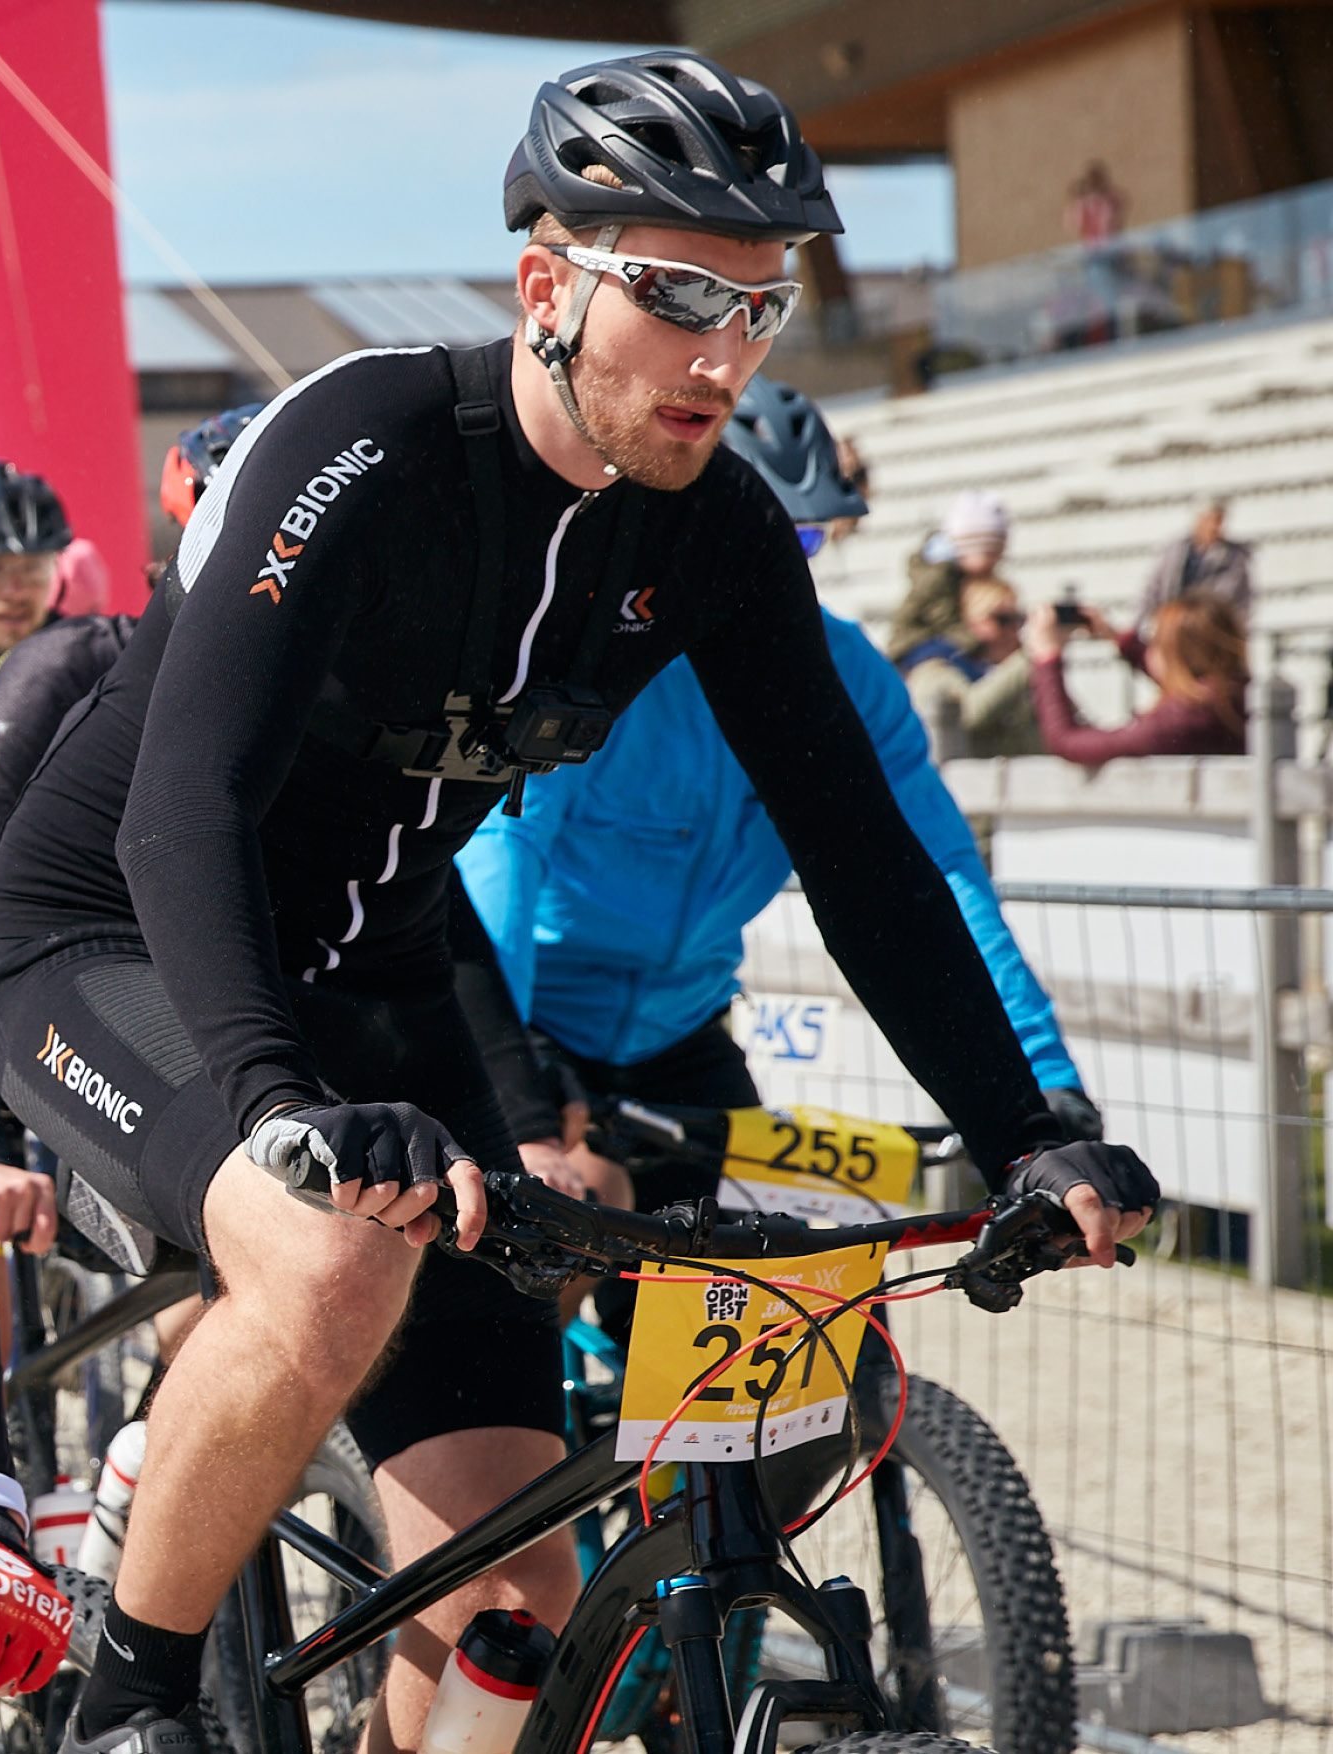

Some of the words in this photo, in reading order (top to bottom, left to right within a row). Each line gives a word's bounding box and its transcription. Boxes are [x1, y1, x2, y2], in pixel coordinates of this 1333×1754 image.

[770, 1123, 878, 1182] 255
[707, 1301, 748, 1321] FEST
[682, 1314, 824, 1402] 251
